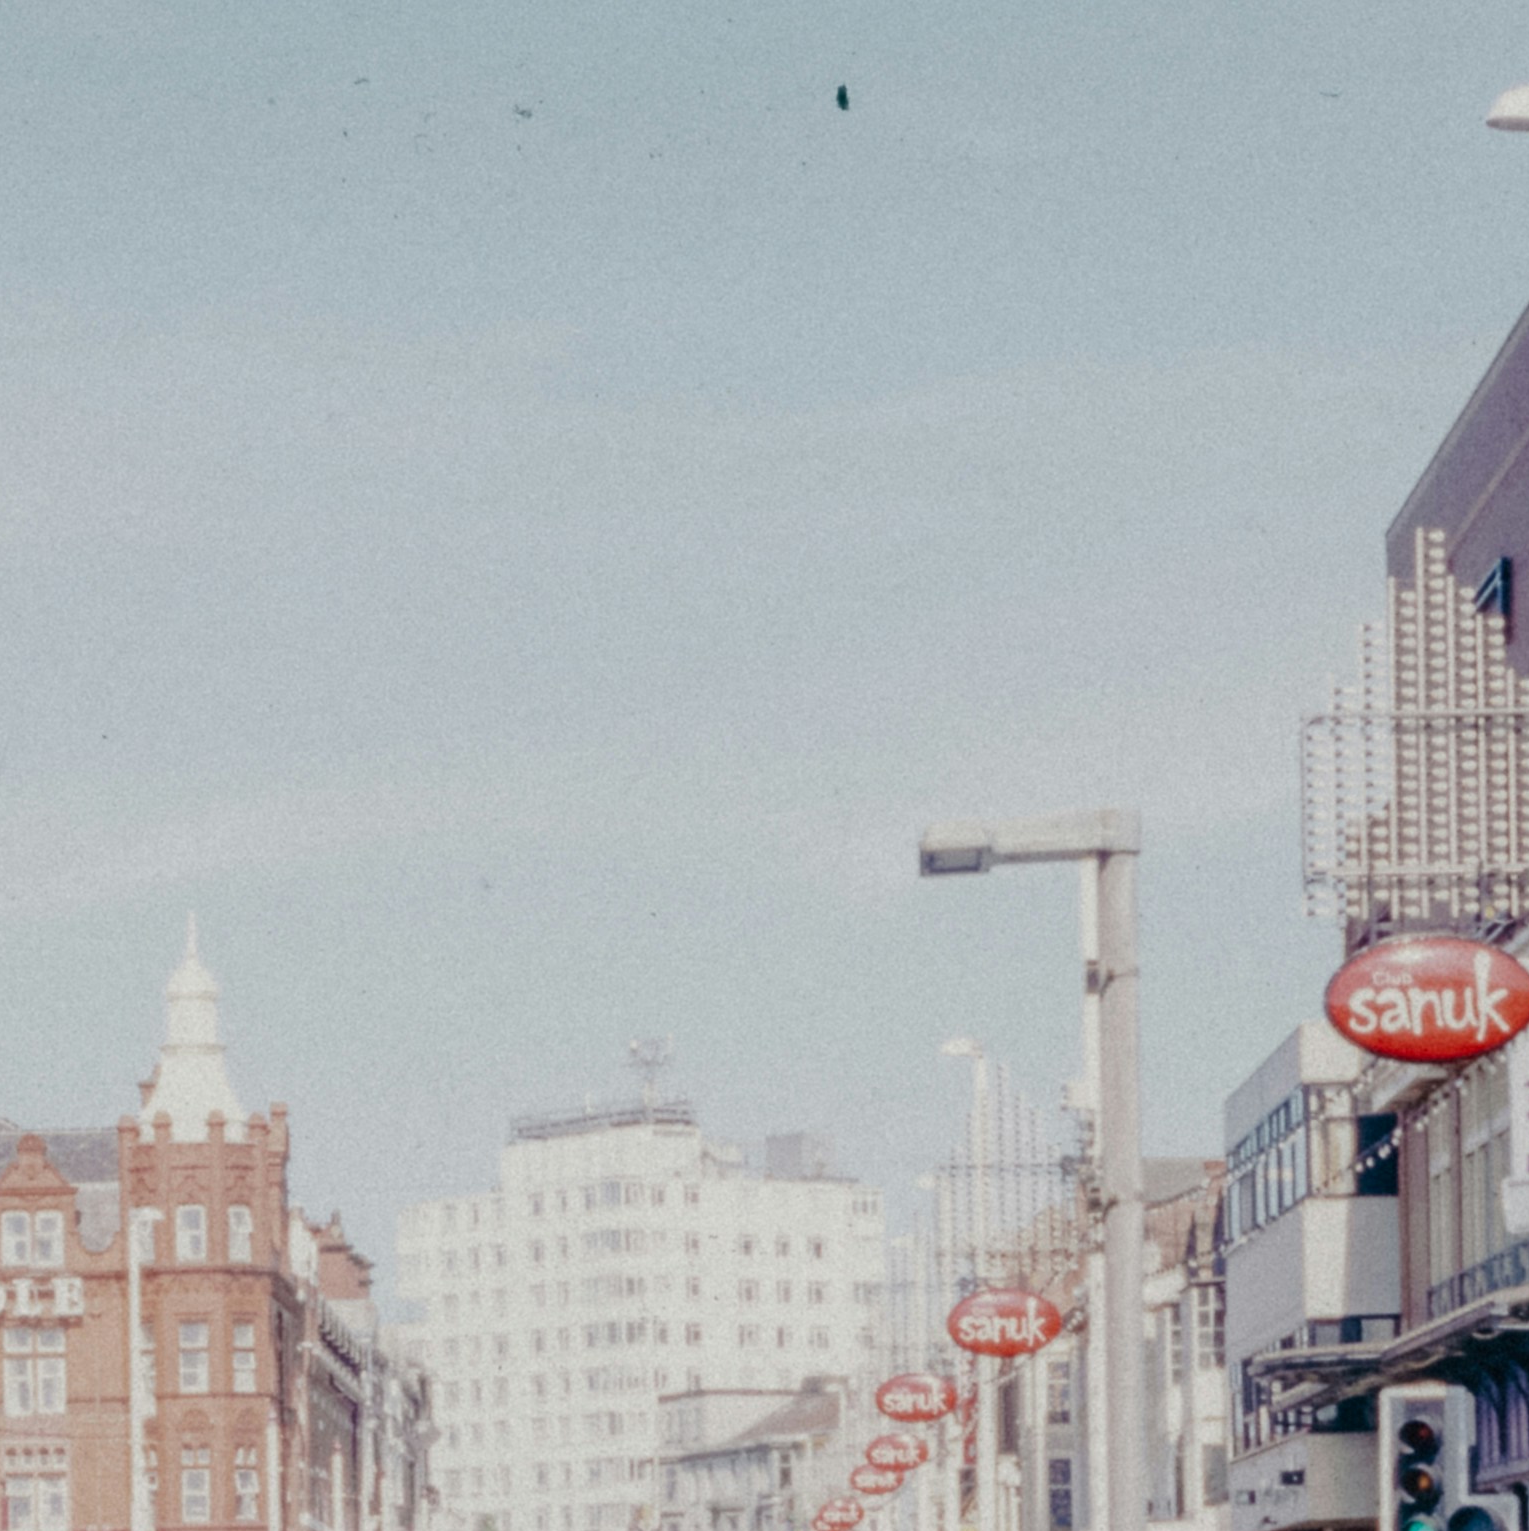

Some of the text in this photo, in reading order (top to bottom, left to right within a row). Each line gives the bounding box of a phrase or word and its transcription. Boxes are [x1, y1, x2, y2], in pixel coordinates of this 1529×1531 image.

[1348, 950, 1511, 1043] sanuk
[1372, 971, 1412, 986] Club
[959, 1297, 1047, 1348] sanuk
[883, 1380, 947, 1416] sanuk
